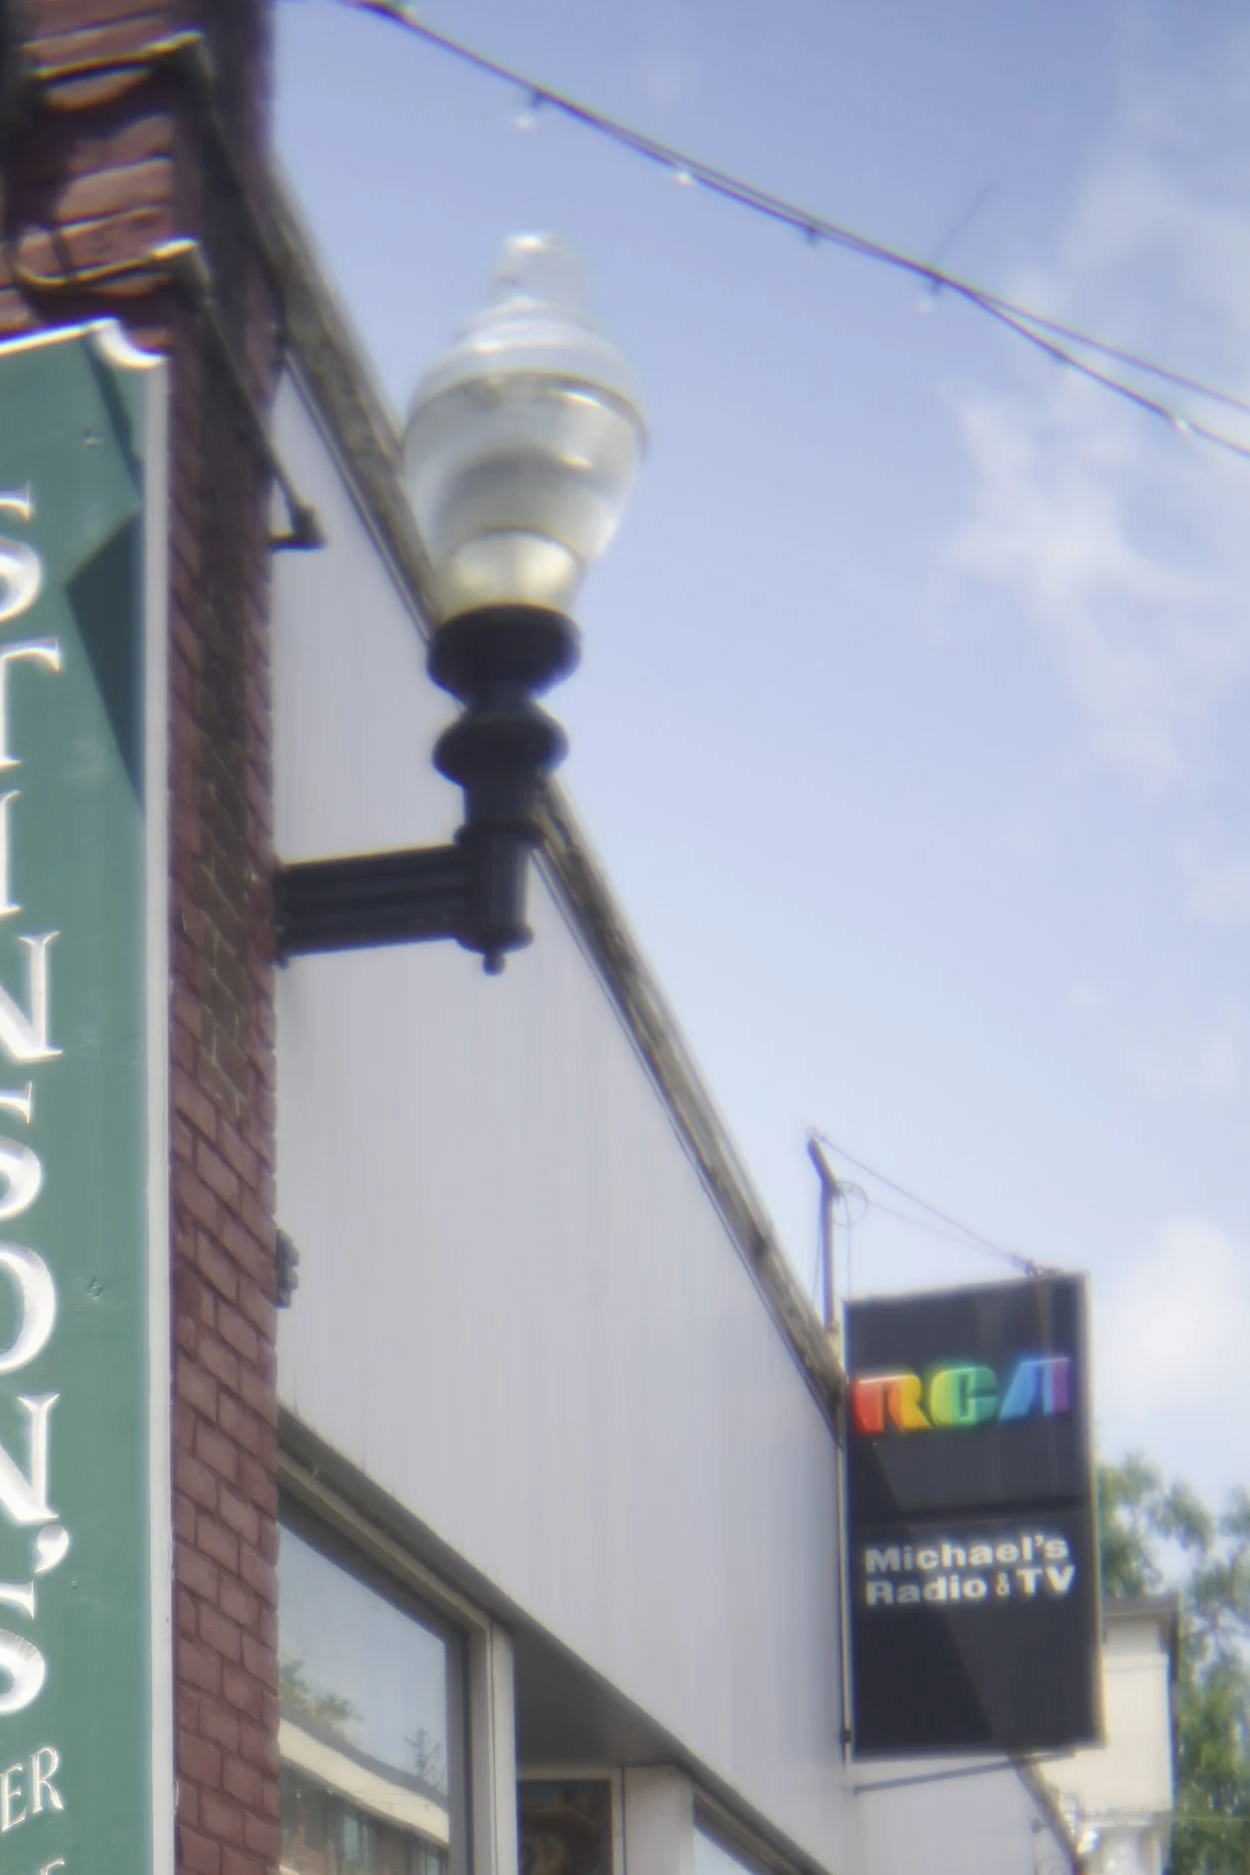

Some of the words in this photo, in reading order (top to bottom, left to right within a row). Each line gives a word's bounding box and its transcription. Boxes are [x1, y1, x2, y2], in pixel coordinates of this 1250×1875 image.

[854, 1356, 1071, 1434] RCA
[864, 1534, 1070, 1574] Michael's
[865, 1574, 988, 1606] Radio
[996, 1571, 1011, 1597] &
[1015, 1565, 1076, 1596] TV
